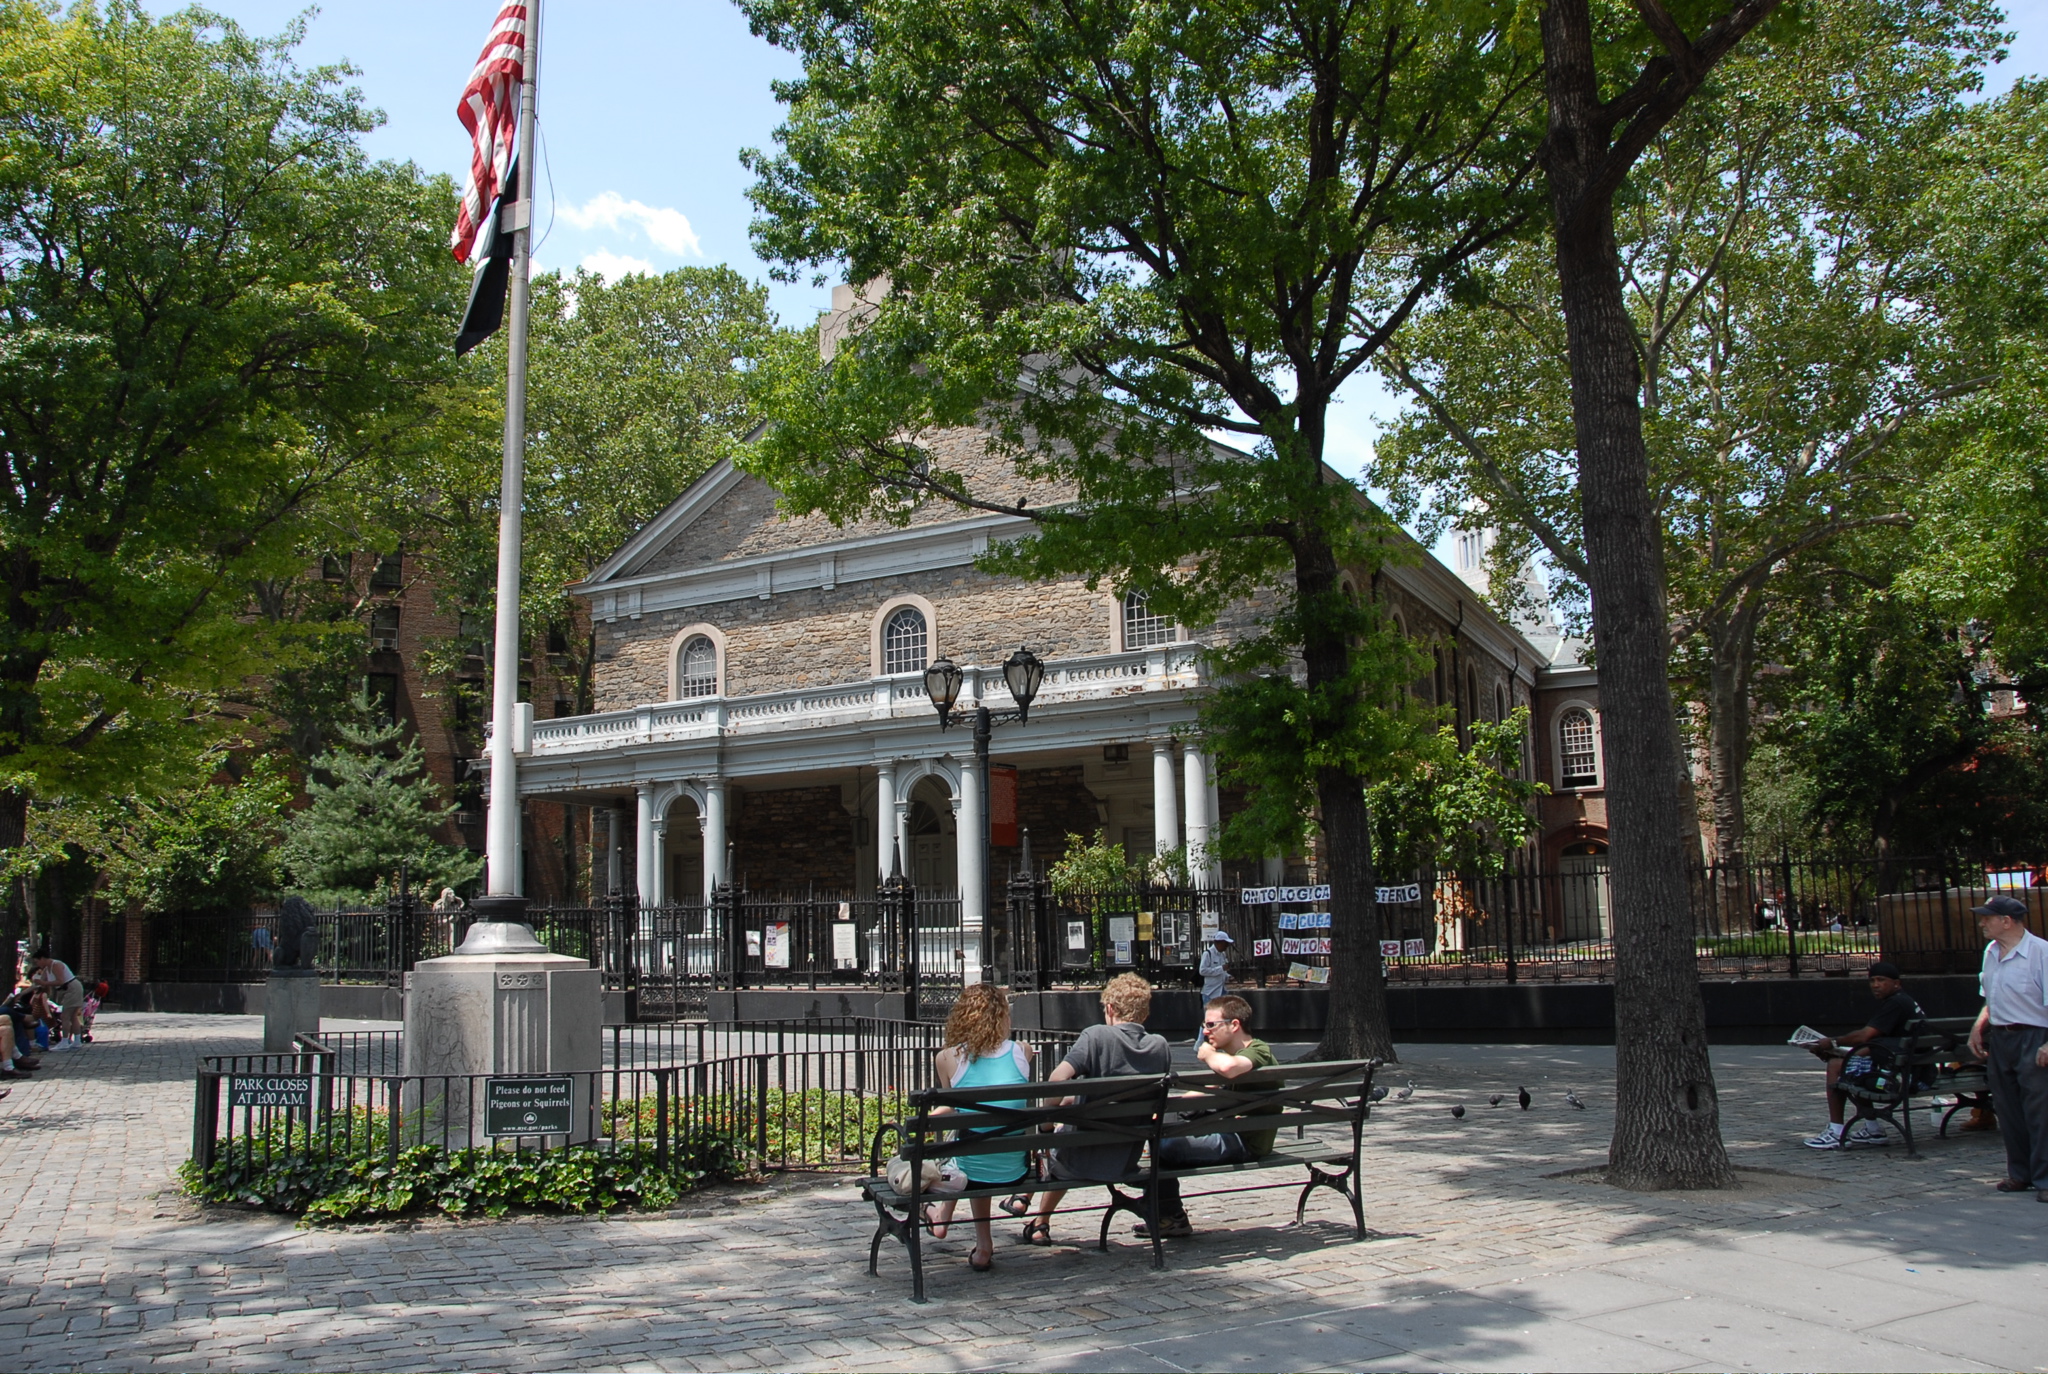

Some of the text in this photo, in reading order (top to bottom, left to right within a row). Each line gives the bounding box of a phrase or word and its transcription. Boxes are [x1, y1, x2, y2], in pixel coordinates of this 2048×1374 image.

[1243, 886, 1419, 903] ONTOLOGICA STERIC
[1280, 914, 1331, 928] INCUBA
[1301, 940, 1332, 953] TON
[1382, 943, 1399, 955] 8
[1405, 940, 1424, 955] PM
[234, 1078, 308, 1091] PARK CLOSES
[495, 1084, 565, 1095] Please do not feed
[236, 1092, 306, 1105] AT 1:00 A.M.
[490, 1098, 570, 1110] Pigeons or Squirrels
